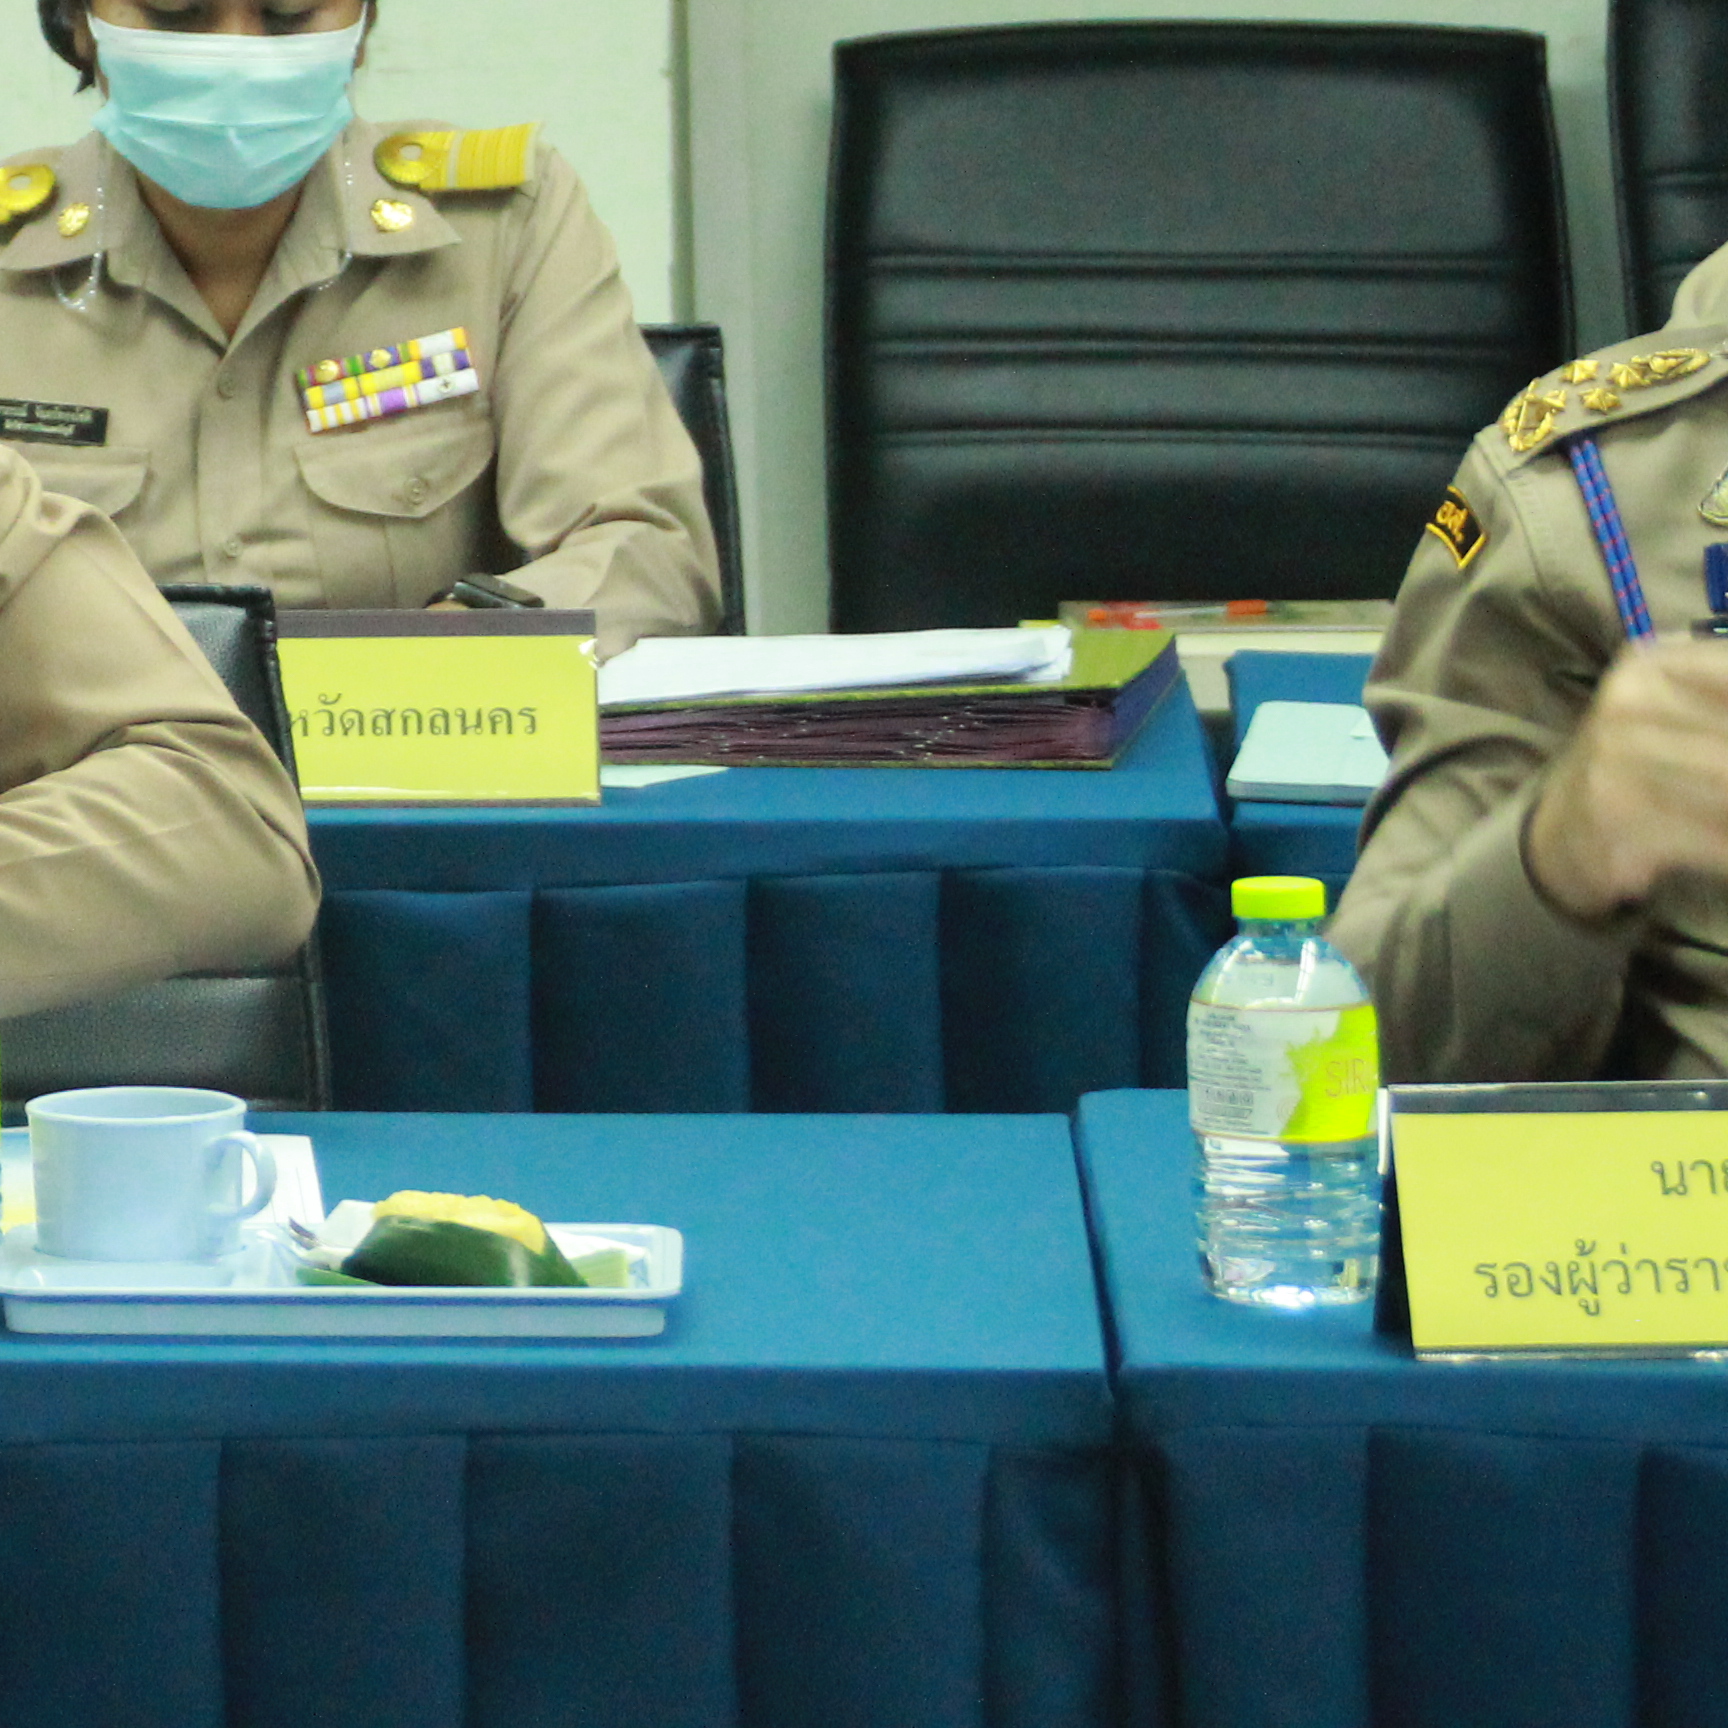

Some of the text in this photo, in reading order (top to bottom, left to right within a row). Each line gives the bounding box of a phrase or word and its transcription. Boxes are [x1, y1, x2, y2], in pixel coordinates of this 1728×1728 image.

[1650, 1158, 1728, 1196] นา
[1473, 1238, 1728, 1317] รองผู้ว่ารา
